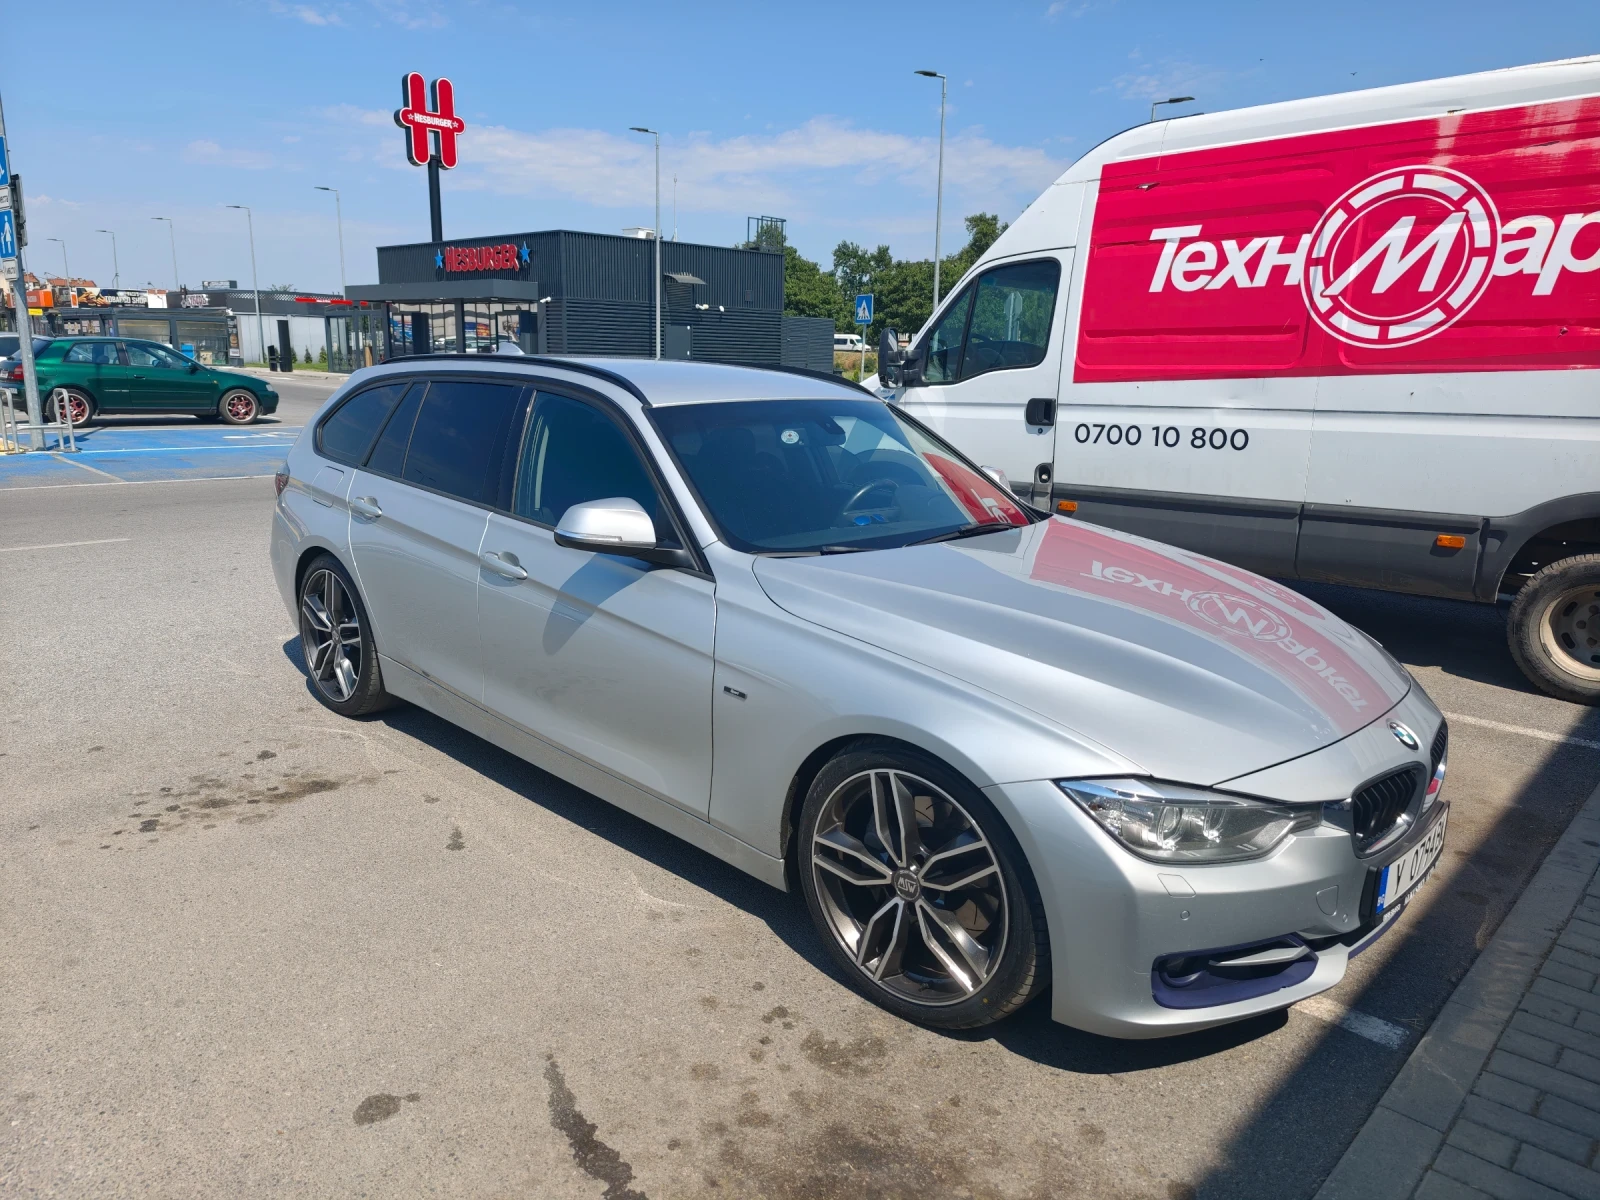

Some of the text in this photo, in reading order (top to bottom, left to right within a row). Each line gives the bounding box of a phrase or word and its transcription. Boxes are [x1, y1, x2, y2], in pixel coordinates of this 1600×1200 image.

[413, 112, 453, 129] HESBURGER
[445, 243, 519, 272] HESBURGER
[132, 296, 147, 304] SHOP
[1074, 423, 1249, 451] 0700 10 800
[897, 877, 917, 893] MSW
